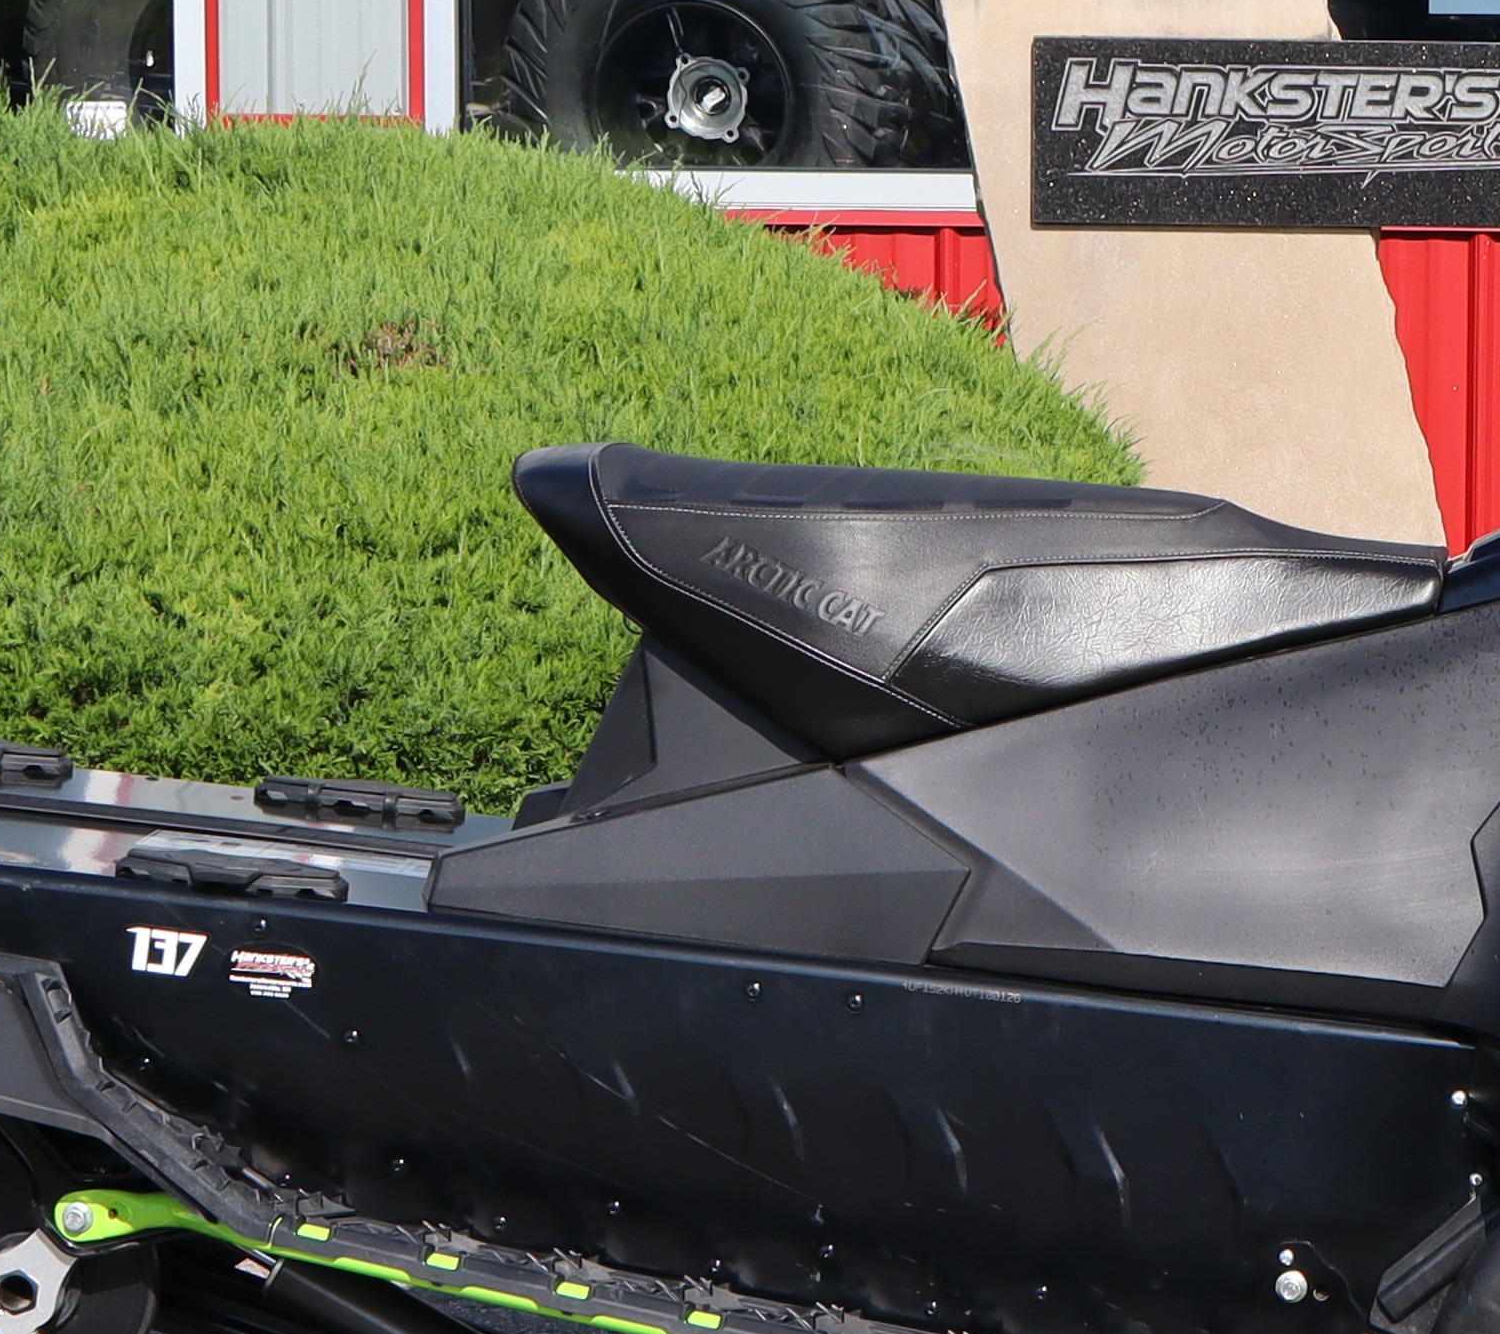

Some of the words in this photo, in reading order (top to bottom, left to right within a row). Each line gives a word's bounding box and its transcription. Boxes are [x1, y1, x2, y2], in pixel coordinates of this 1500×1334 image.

[701, 535, 825, 609] ARCTIC
[817, 589, 886, 637] CAT
[124, 925, 209, 977] 137
